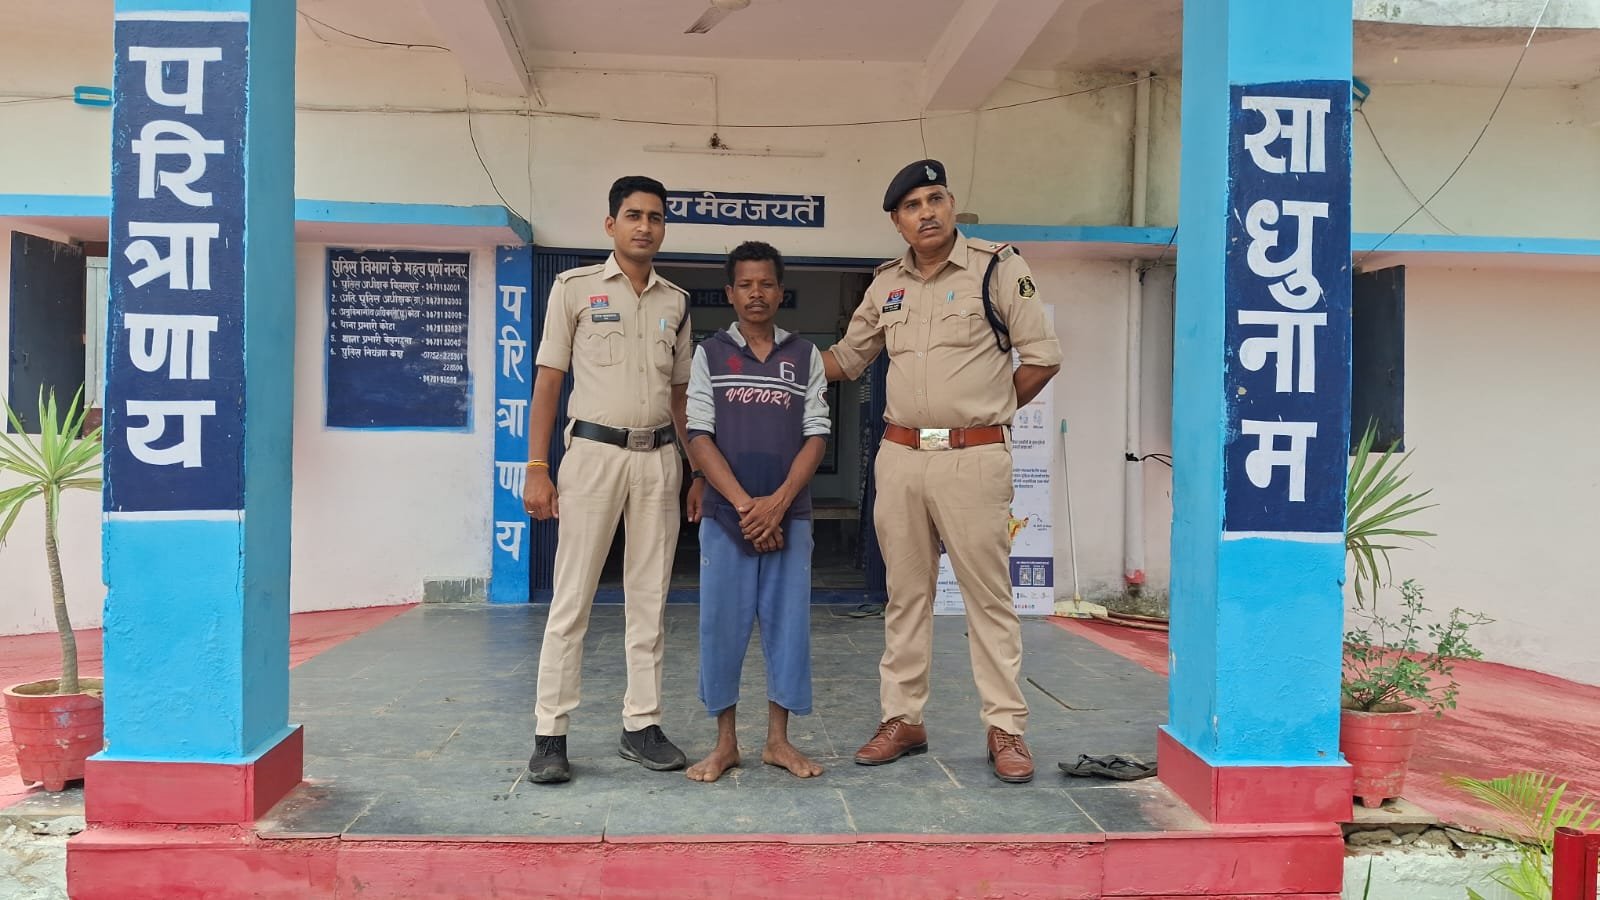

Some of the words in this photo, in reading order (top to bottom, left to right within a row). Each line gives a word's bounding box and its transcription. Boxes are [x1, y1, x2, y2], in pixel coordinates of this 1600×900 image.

[332, 256, 357, 278] पुलिस
[360, 256, 390, 275] विभाग
[390, 256, 402, 275] के
[359, 292, 380, 307] पुलिस
[341, 345, 361, 360] पुलिस
[780, 361, 796, 382] 6
[725, 387, 791, 410] VICTORY
